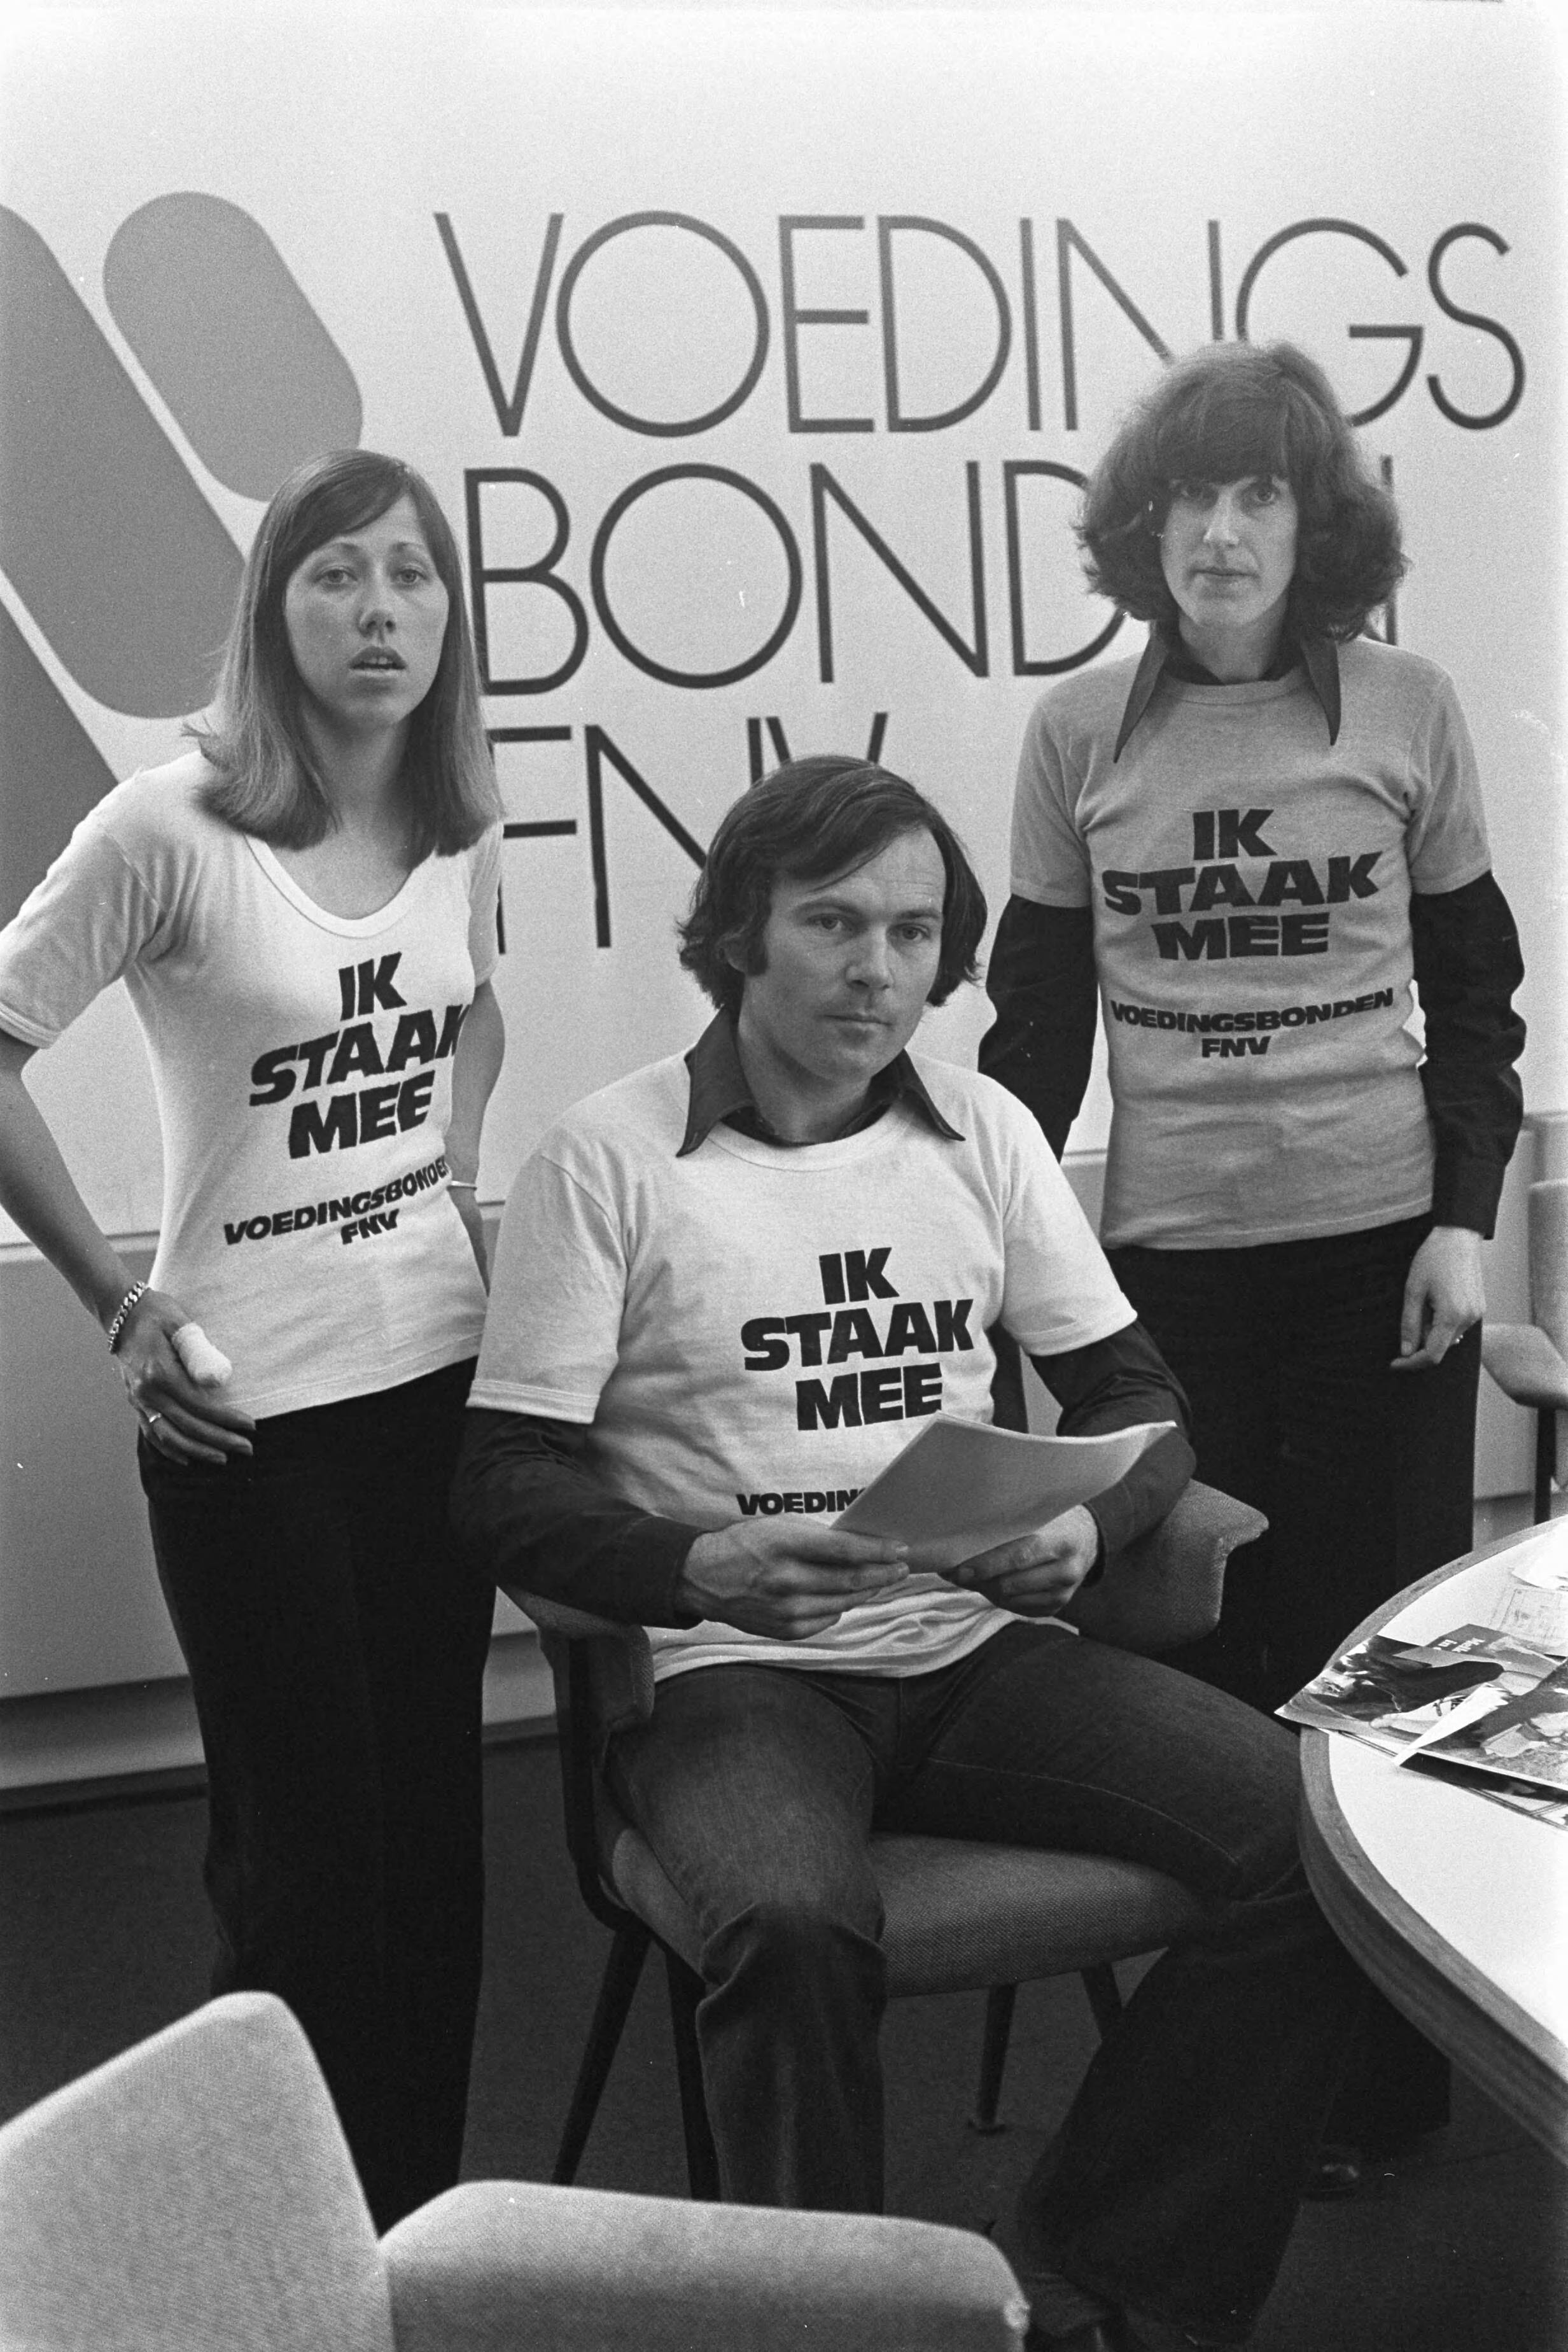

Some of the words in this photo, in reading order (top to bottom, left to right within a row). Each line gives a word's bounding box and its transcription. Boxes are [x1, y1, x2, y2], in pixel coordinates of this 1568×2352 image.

[433, 210, 1525, 438] VOEDINGS
[1193, 809, 1277, 860] IK
[1102, 851, 1382, 916] STAAK
[1150, 911, 1330, 961] MEE
[339, 951, 407, 1021] IK
[1110, 988, 1394, 1033] VOEDINGSBONDEN
[1201, 1035, 1271, 1058] FNV
[288, 1069, 435, 1159] MEE
[340, 1208, 399, 1245] FNV
[819, 1247, 900, 1305] IK
[741, 1299, 974, 1371] STAAK
[795, 1362, 942, 1431] MEE
[736, 1487, 866, 1516] VOEDIN
